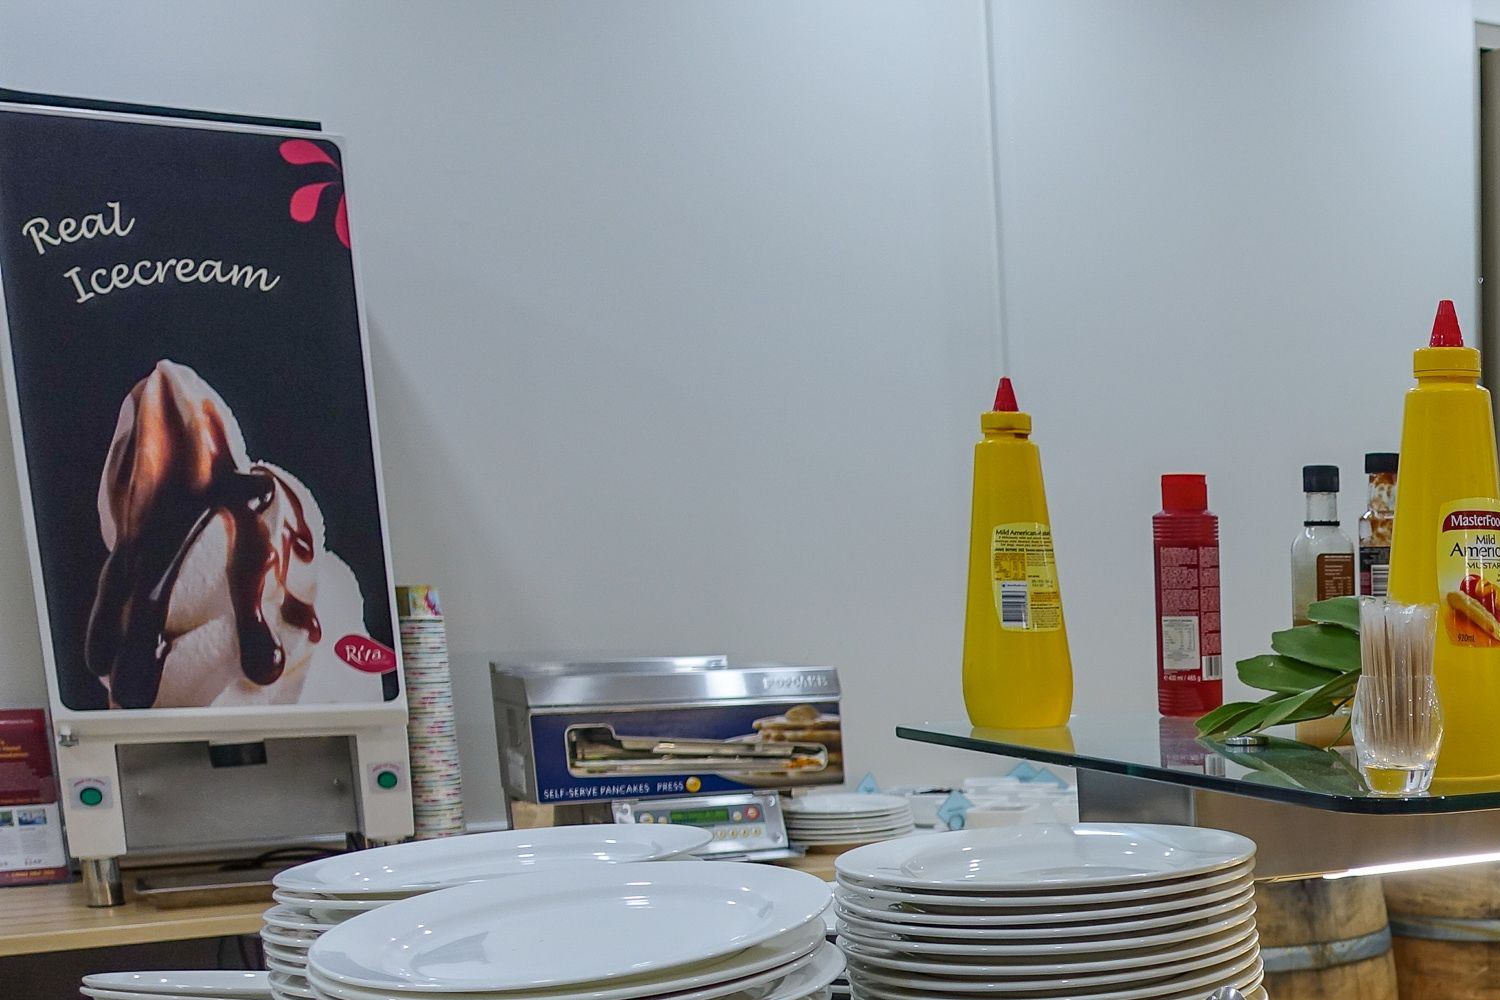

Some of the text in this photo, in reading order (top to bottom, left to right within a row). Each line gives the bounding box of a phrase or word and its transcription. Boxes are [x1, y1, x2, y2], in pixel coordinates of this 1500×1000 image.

[22, 201, 136, 255] Real
[63, 258, 281, 304] Icecream
[1476, 534, 1496, 545] Mild
[543, 780, 684, 800] SELF-SERVE PANCAKES PRESS
